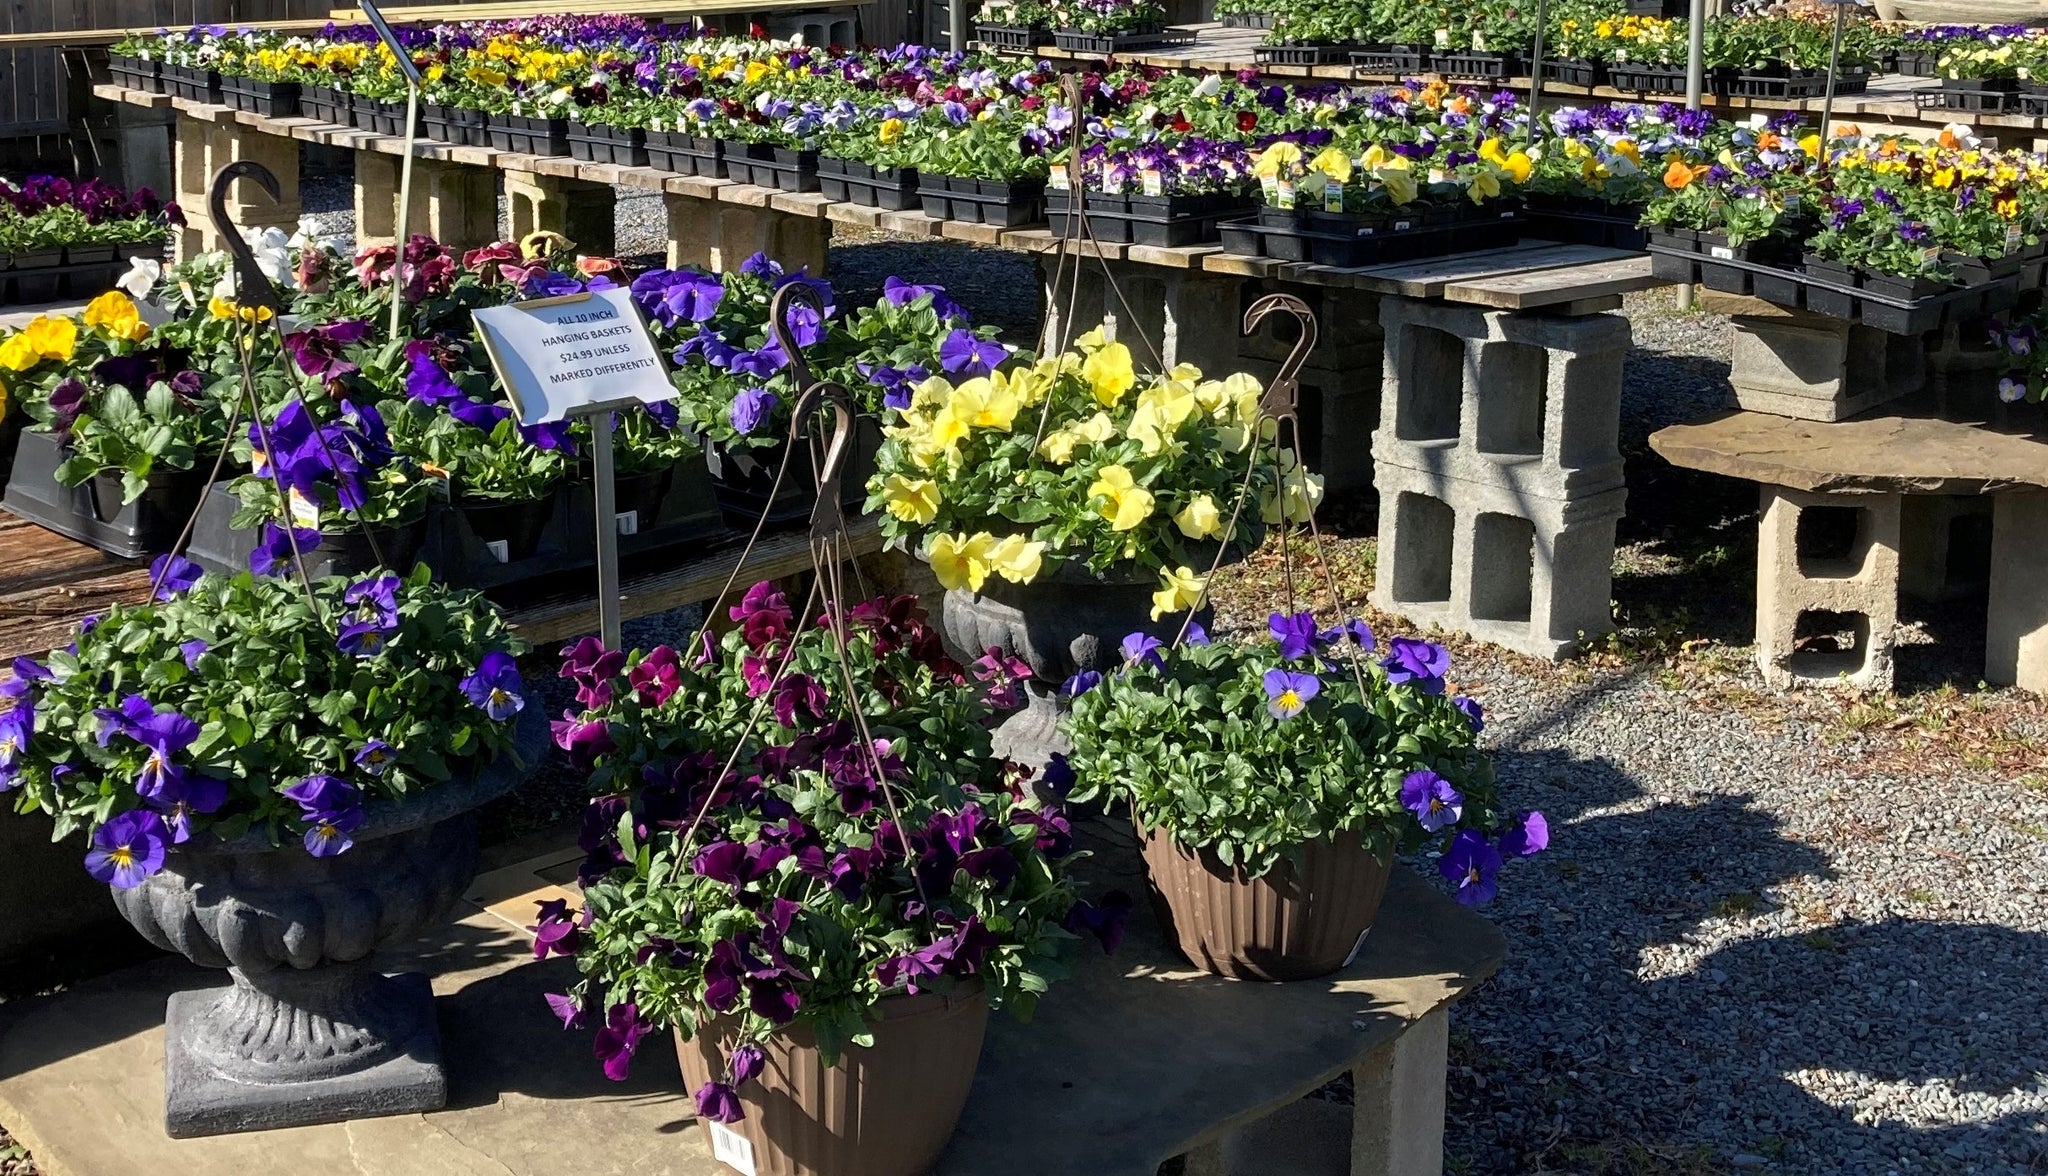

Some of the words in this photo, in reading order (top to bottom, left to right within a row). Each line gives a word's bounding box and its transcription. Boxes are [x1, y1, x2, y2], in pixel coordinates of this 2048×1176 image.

[557, 316, 574, 325] ALL
[575, 313, 588, 323] 10
[589, 310, 613, 320] INCH
[542, 332, 590, 347] HANGING
[591, 325, 632, 339] BASKETS
[560, 350, 593, 364] $24.99
[594, 344, 631, 357] UNLESS
[550, 369, 593, 384] MARKED
[594, 357, 655, 376] DIFFERENTLY
